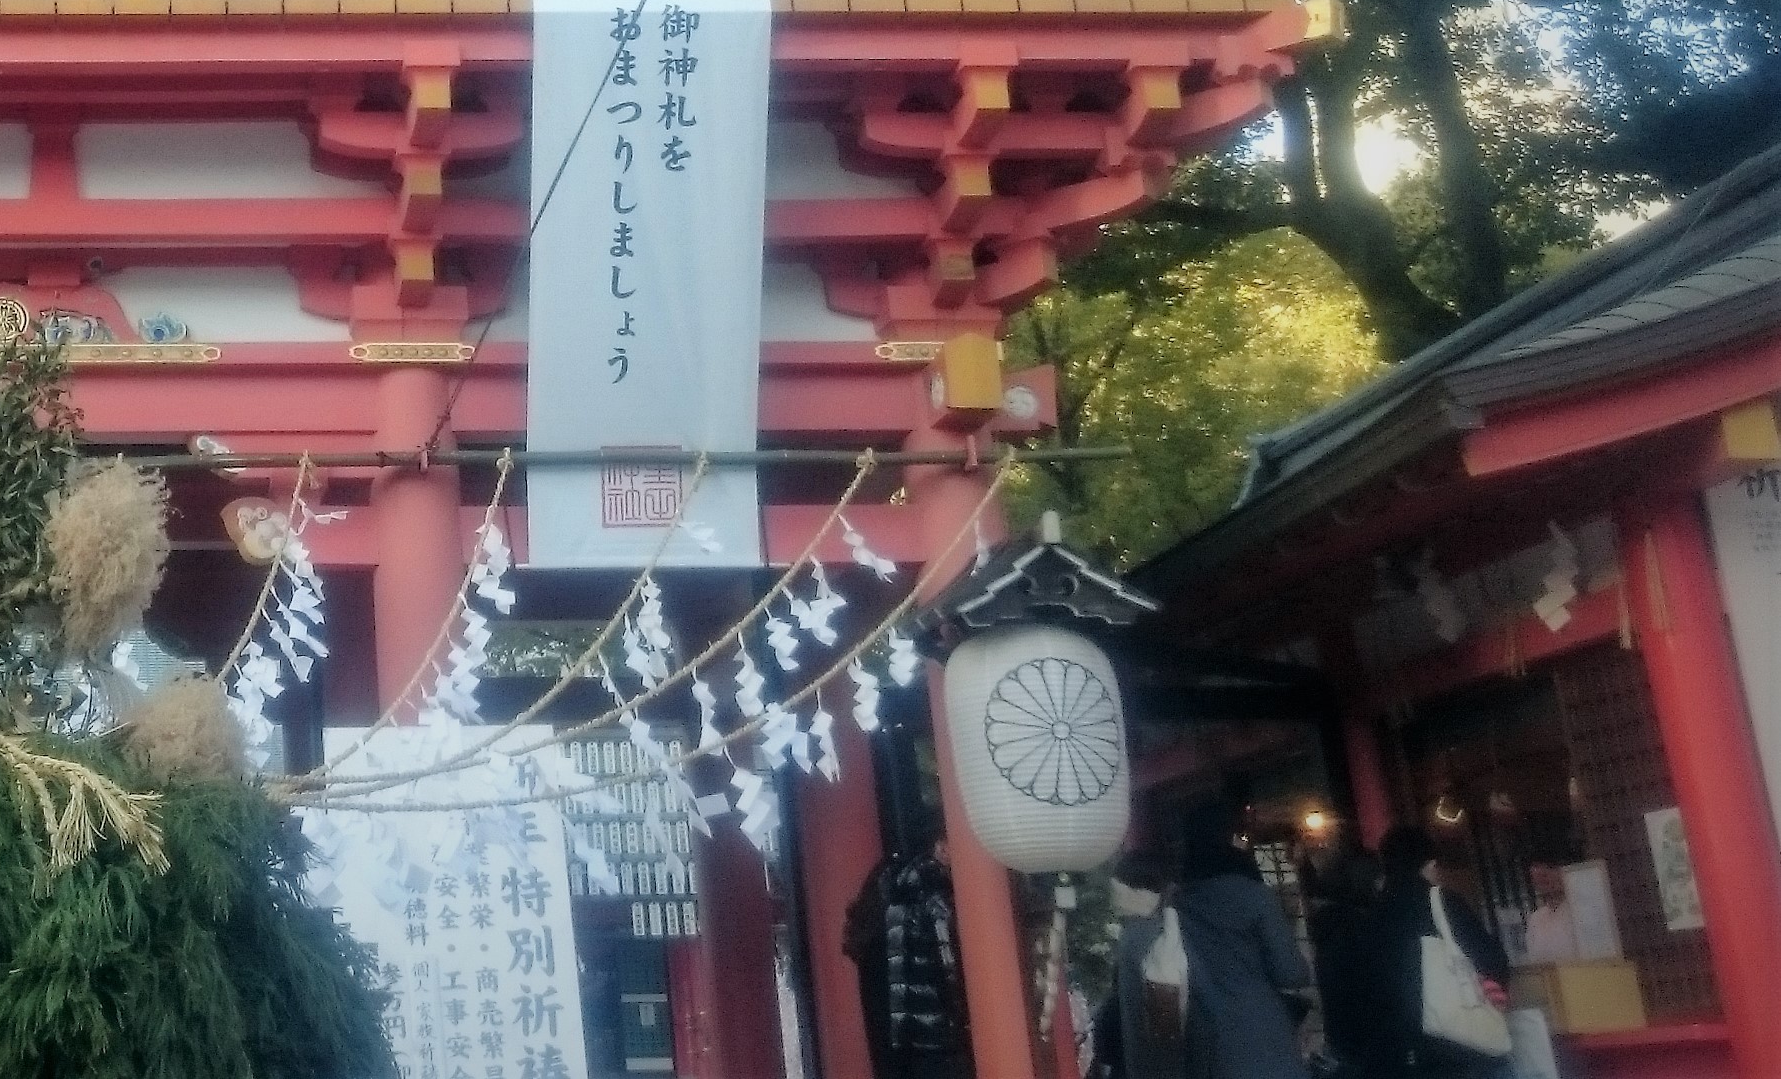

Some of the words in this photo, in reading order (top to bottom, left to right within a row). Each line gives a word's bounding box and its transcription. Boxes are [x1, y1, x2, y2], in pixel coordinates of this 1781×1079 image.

[606, 7, 643, 384] おまつりしましょう
[656, 4, 700, 172] 御神札を
